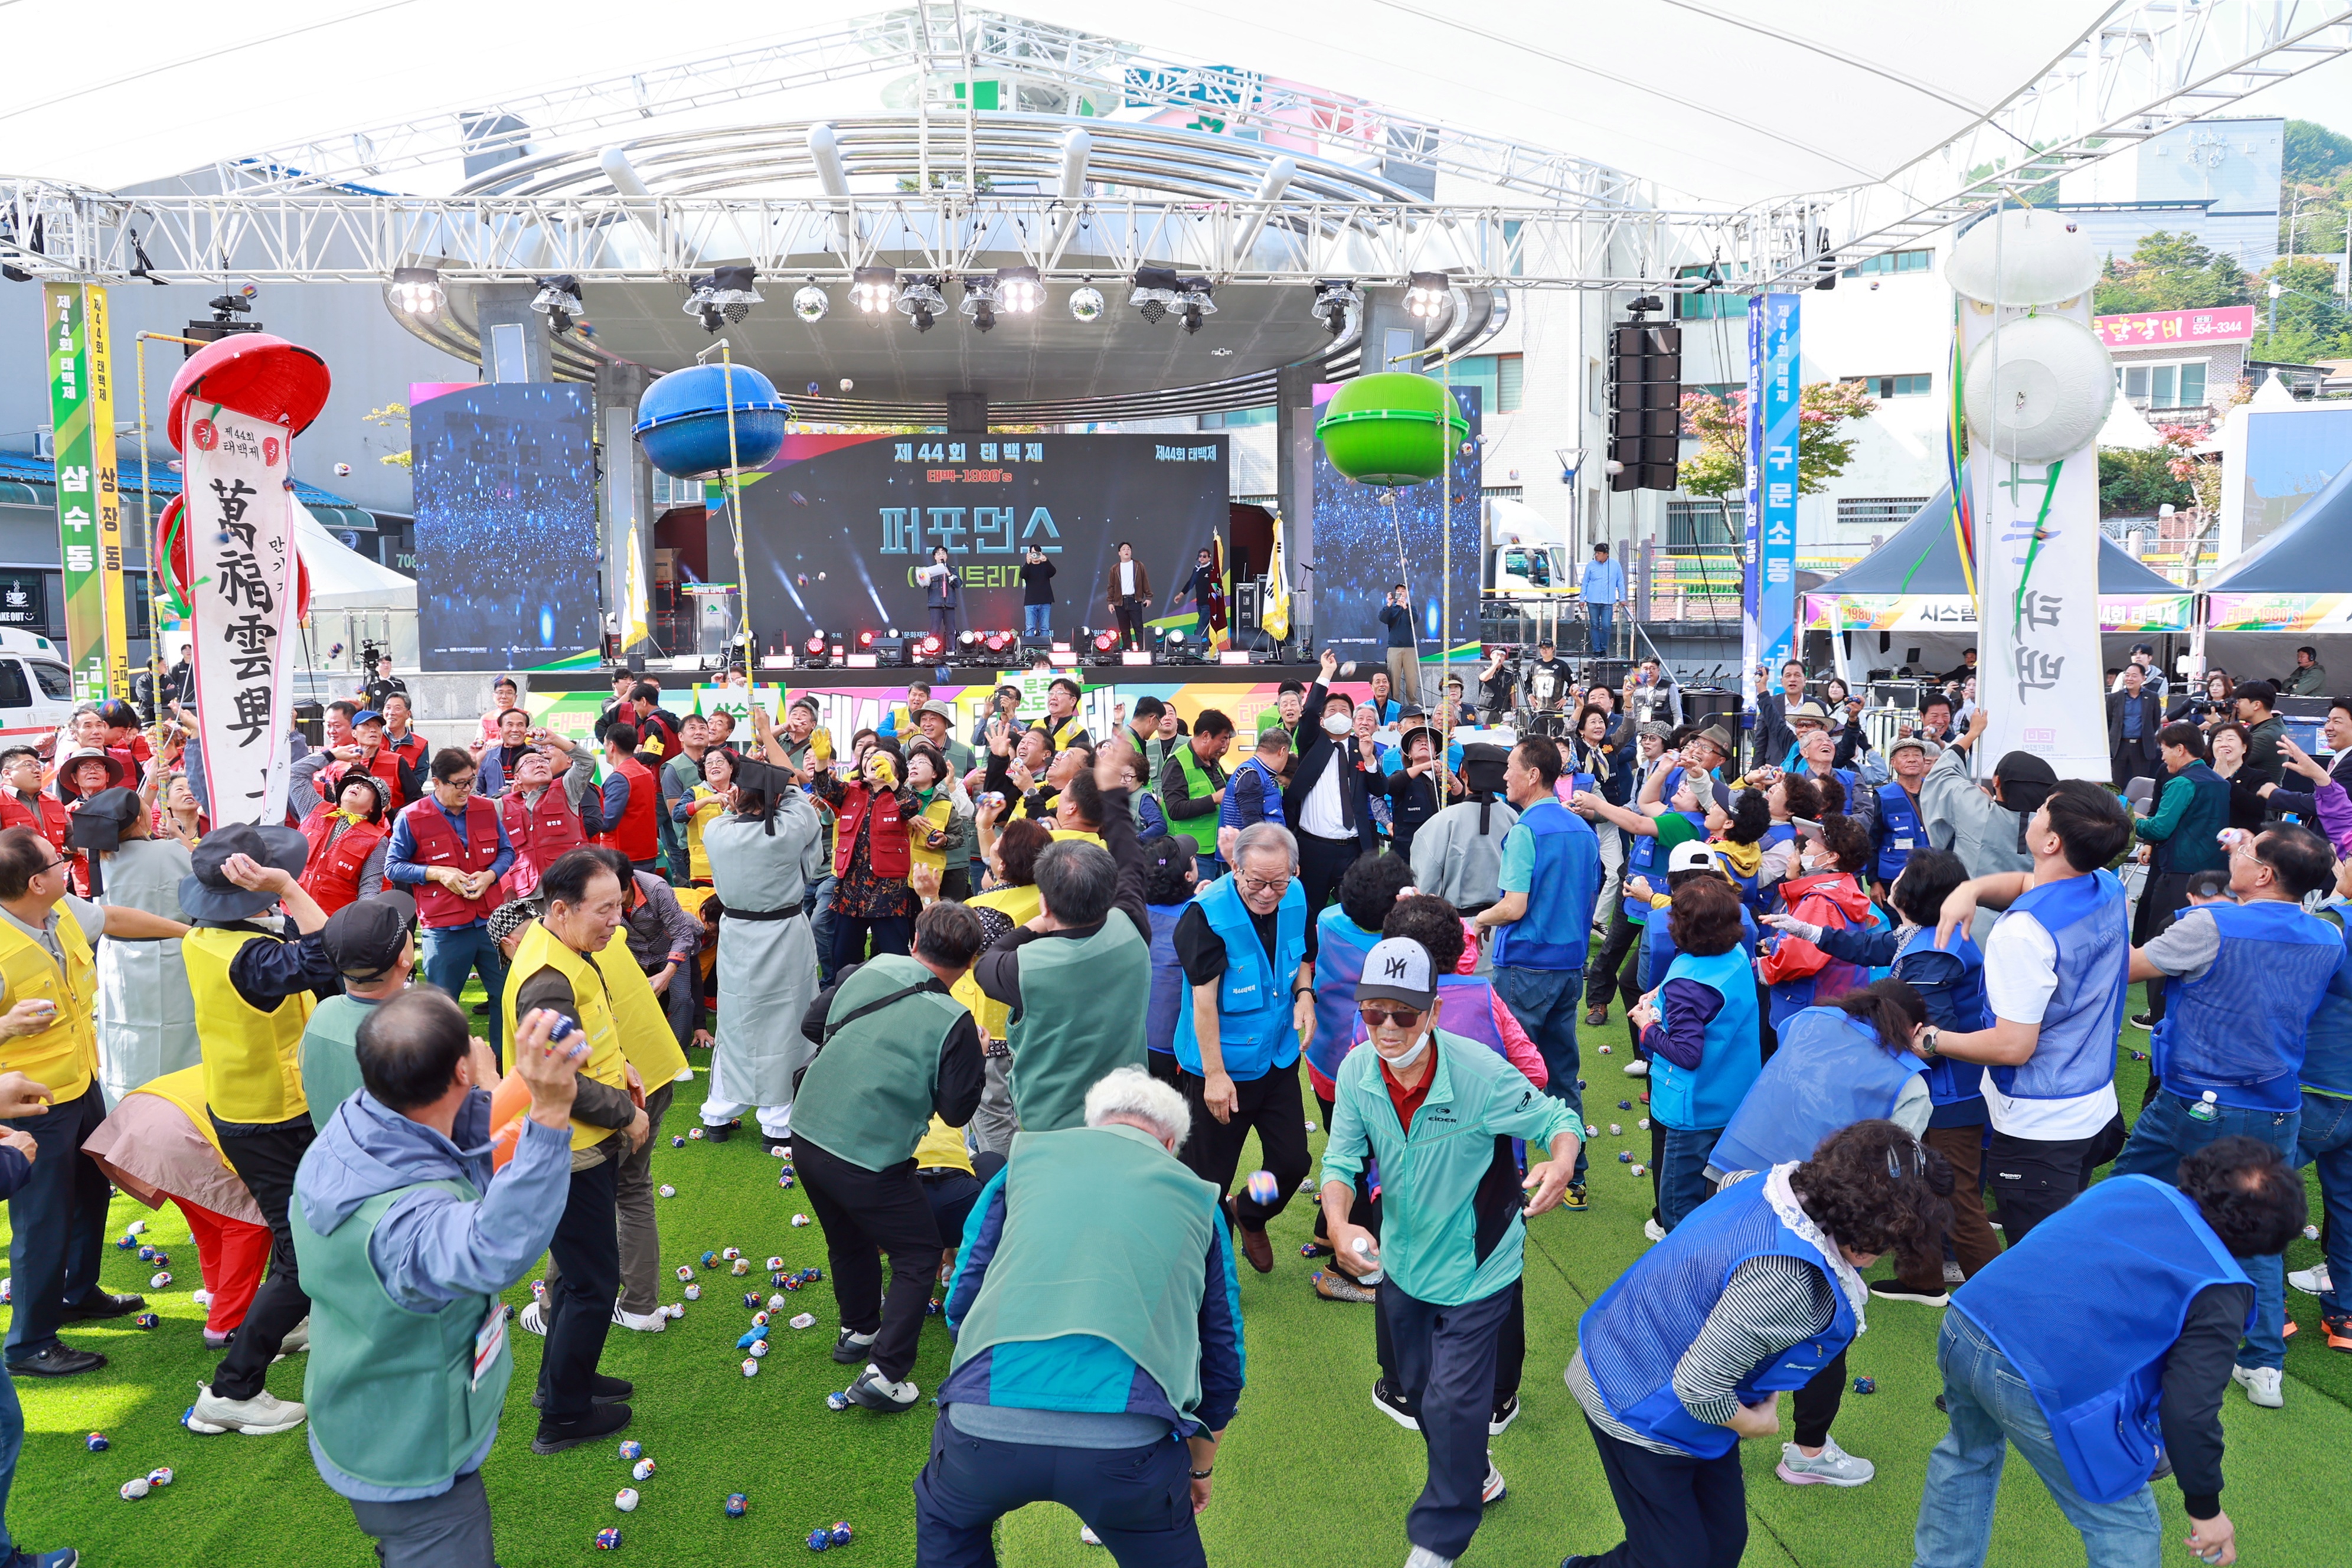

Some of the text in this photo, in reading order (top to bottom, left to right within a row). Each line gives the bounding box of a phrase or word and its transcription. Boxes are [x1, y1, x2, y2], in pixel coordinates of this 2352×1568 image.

[2192, 321, 2242, 335] 554-3344
[57, 295, 77, 399] 제44회 태백제
[1776, 305, 1789, 403] 제44회 태백제
[97, 360, 106, 401] 태백제
[224, 426, 255, 443] 제44회
[223, 440, 259, 461] 태백제
[894, 442, 1043, 462] 제44회 태백제
[1155, 444, 1216, 462] 제44회 태백제
[927, 469, 1012, 482] 태백-1980's
[61, 466, 93, 571] 삼수동
[101, 467, 120, 571] 상장동
[1767, 446, 1792, 583] 구문소동
[879, 507, 1063, 554] 퍼포먼스
[11, 612, 24, 622] OUT
[2131, 601, 2178, 626] 태백제
[2226, 607, 2301, 624] 태백-1980's
